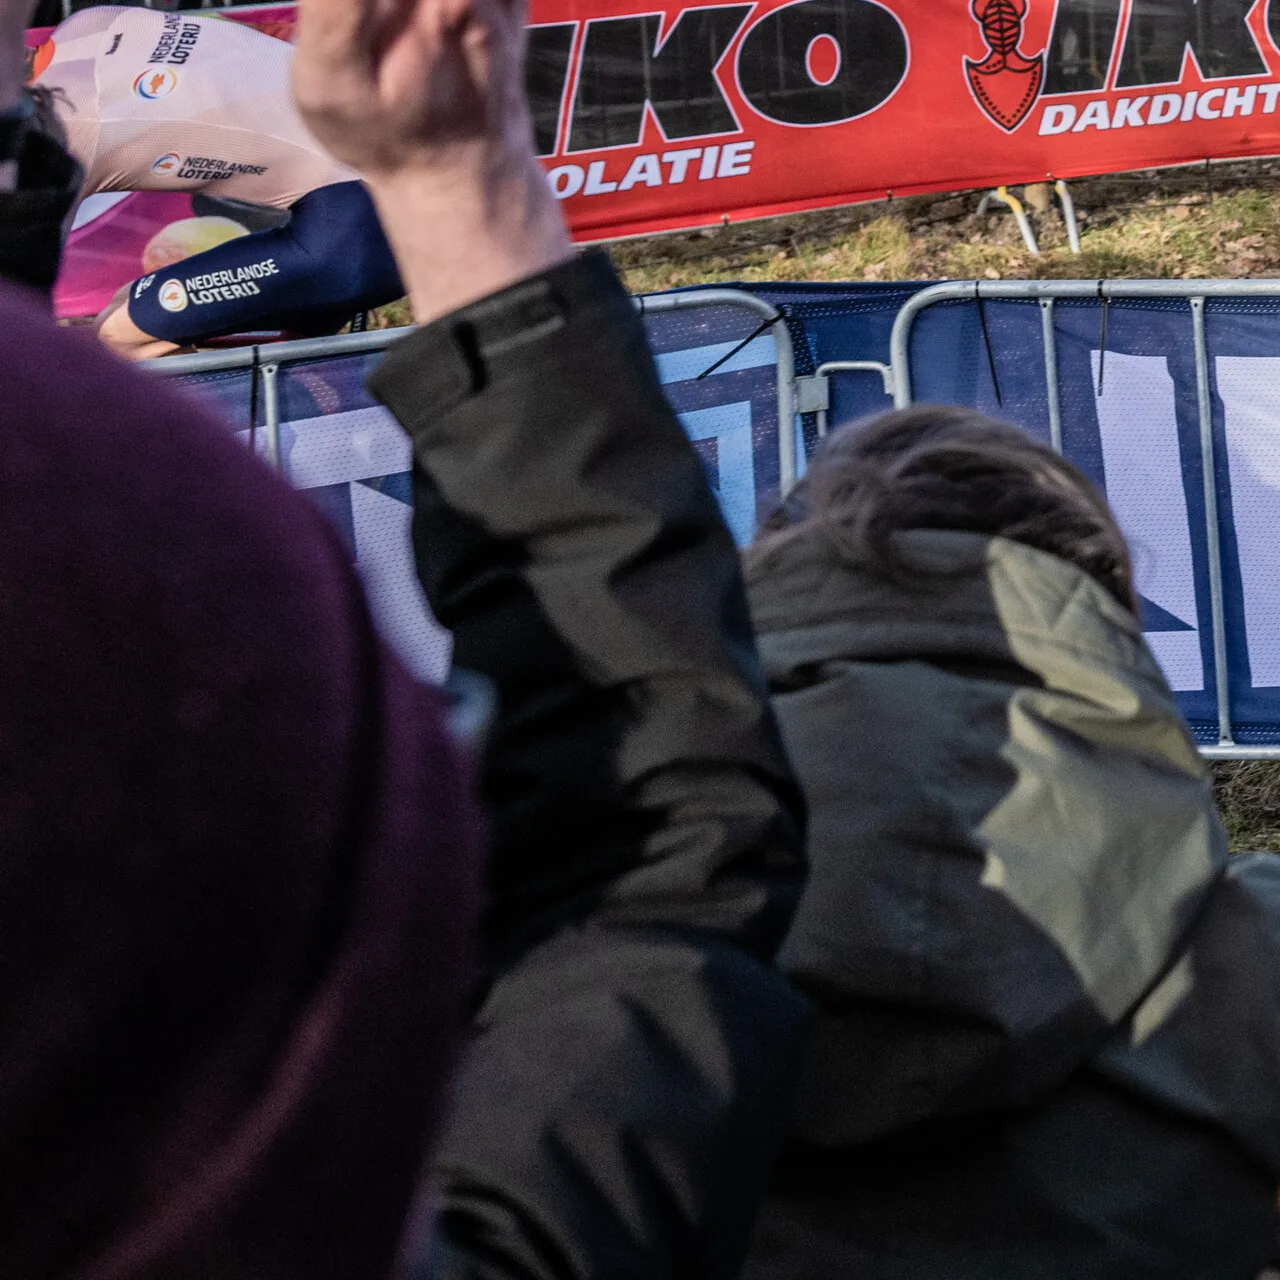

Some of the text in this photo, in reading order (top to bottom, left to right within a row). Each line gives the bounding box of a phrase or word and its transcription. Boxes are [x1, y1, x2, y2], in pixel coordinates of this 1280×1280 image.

[183, 156, 268, 176] NEDERLANDSE
[546, 140, 756, 201] OLATIE
[185, 258, 280, 292] NEDERLANDSE
[189, 281, 261, 306] LOTERIJ
